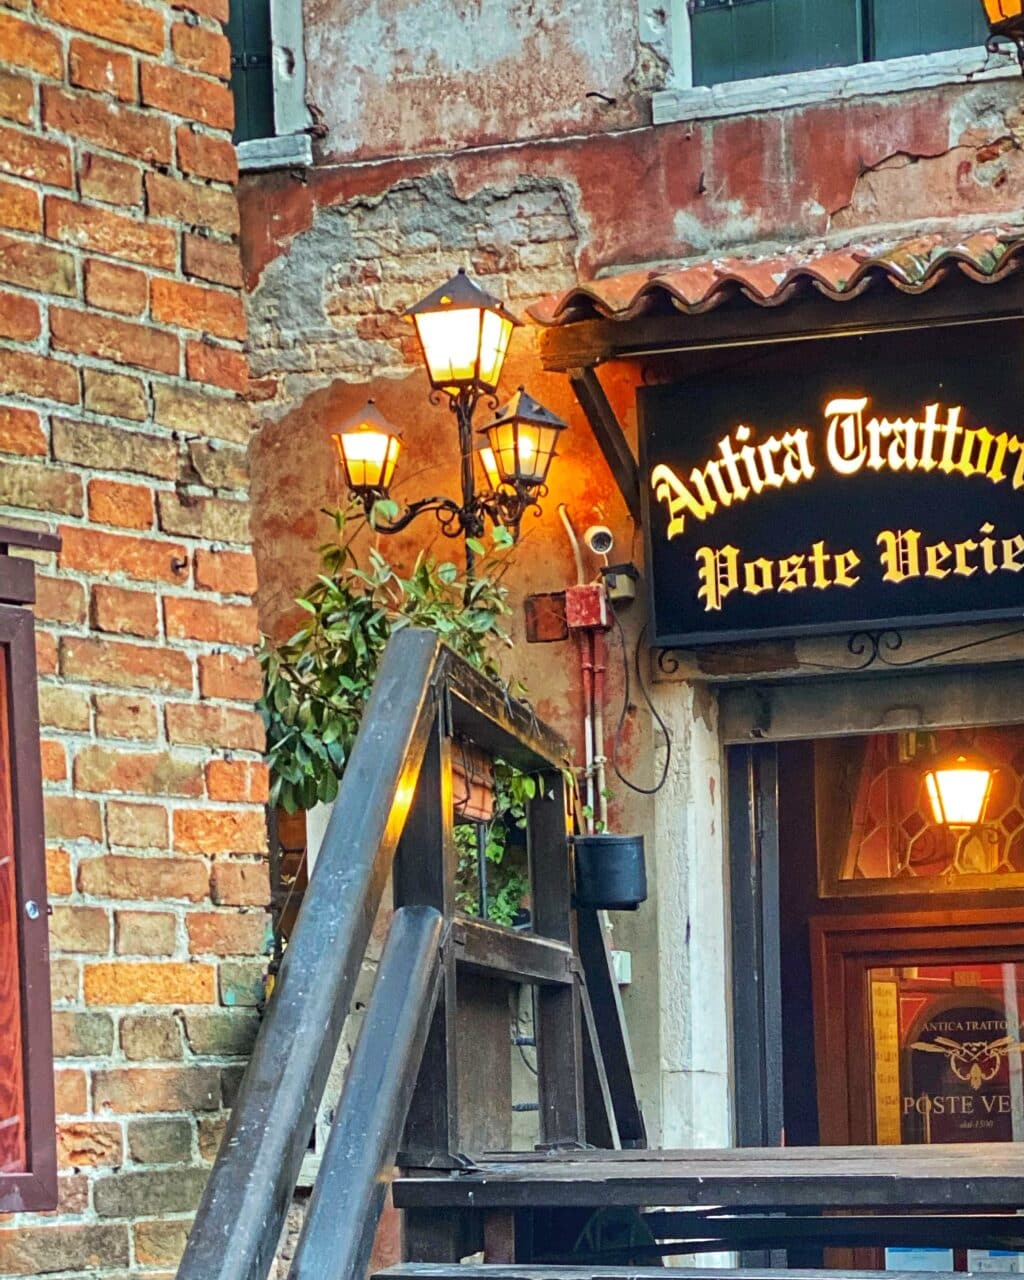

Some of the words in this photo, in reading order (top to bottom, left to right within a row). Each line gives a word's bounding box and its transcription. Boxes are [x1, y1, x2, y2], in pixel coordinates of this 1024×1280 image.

[651, 425, 815, 540] Antica
[696, 541, 860, 612] Poste
[922, 1021, 964, 1031] ANTICA
[903, 1095, 975, 1115] POSTE
